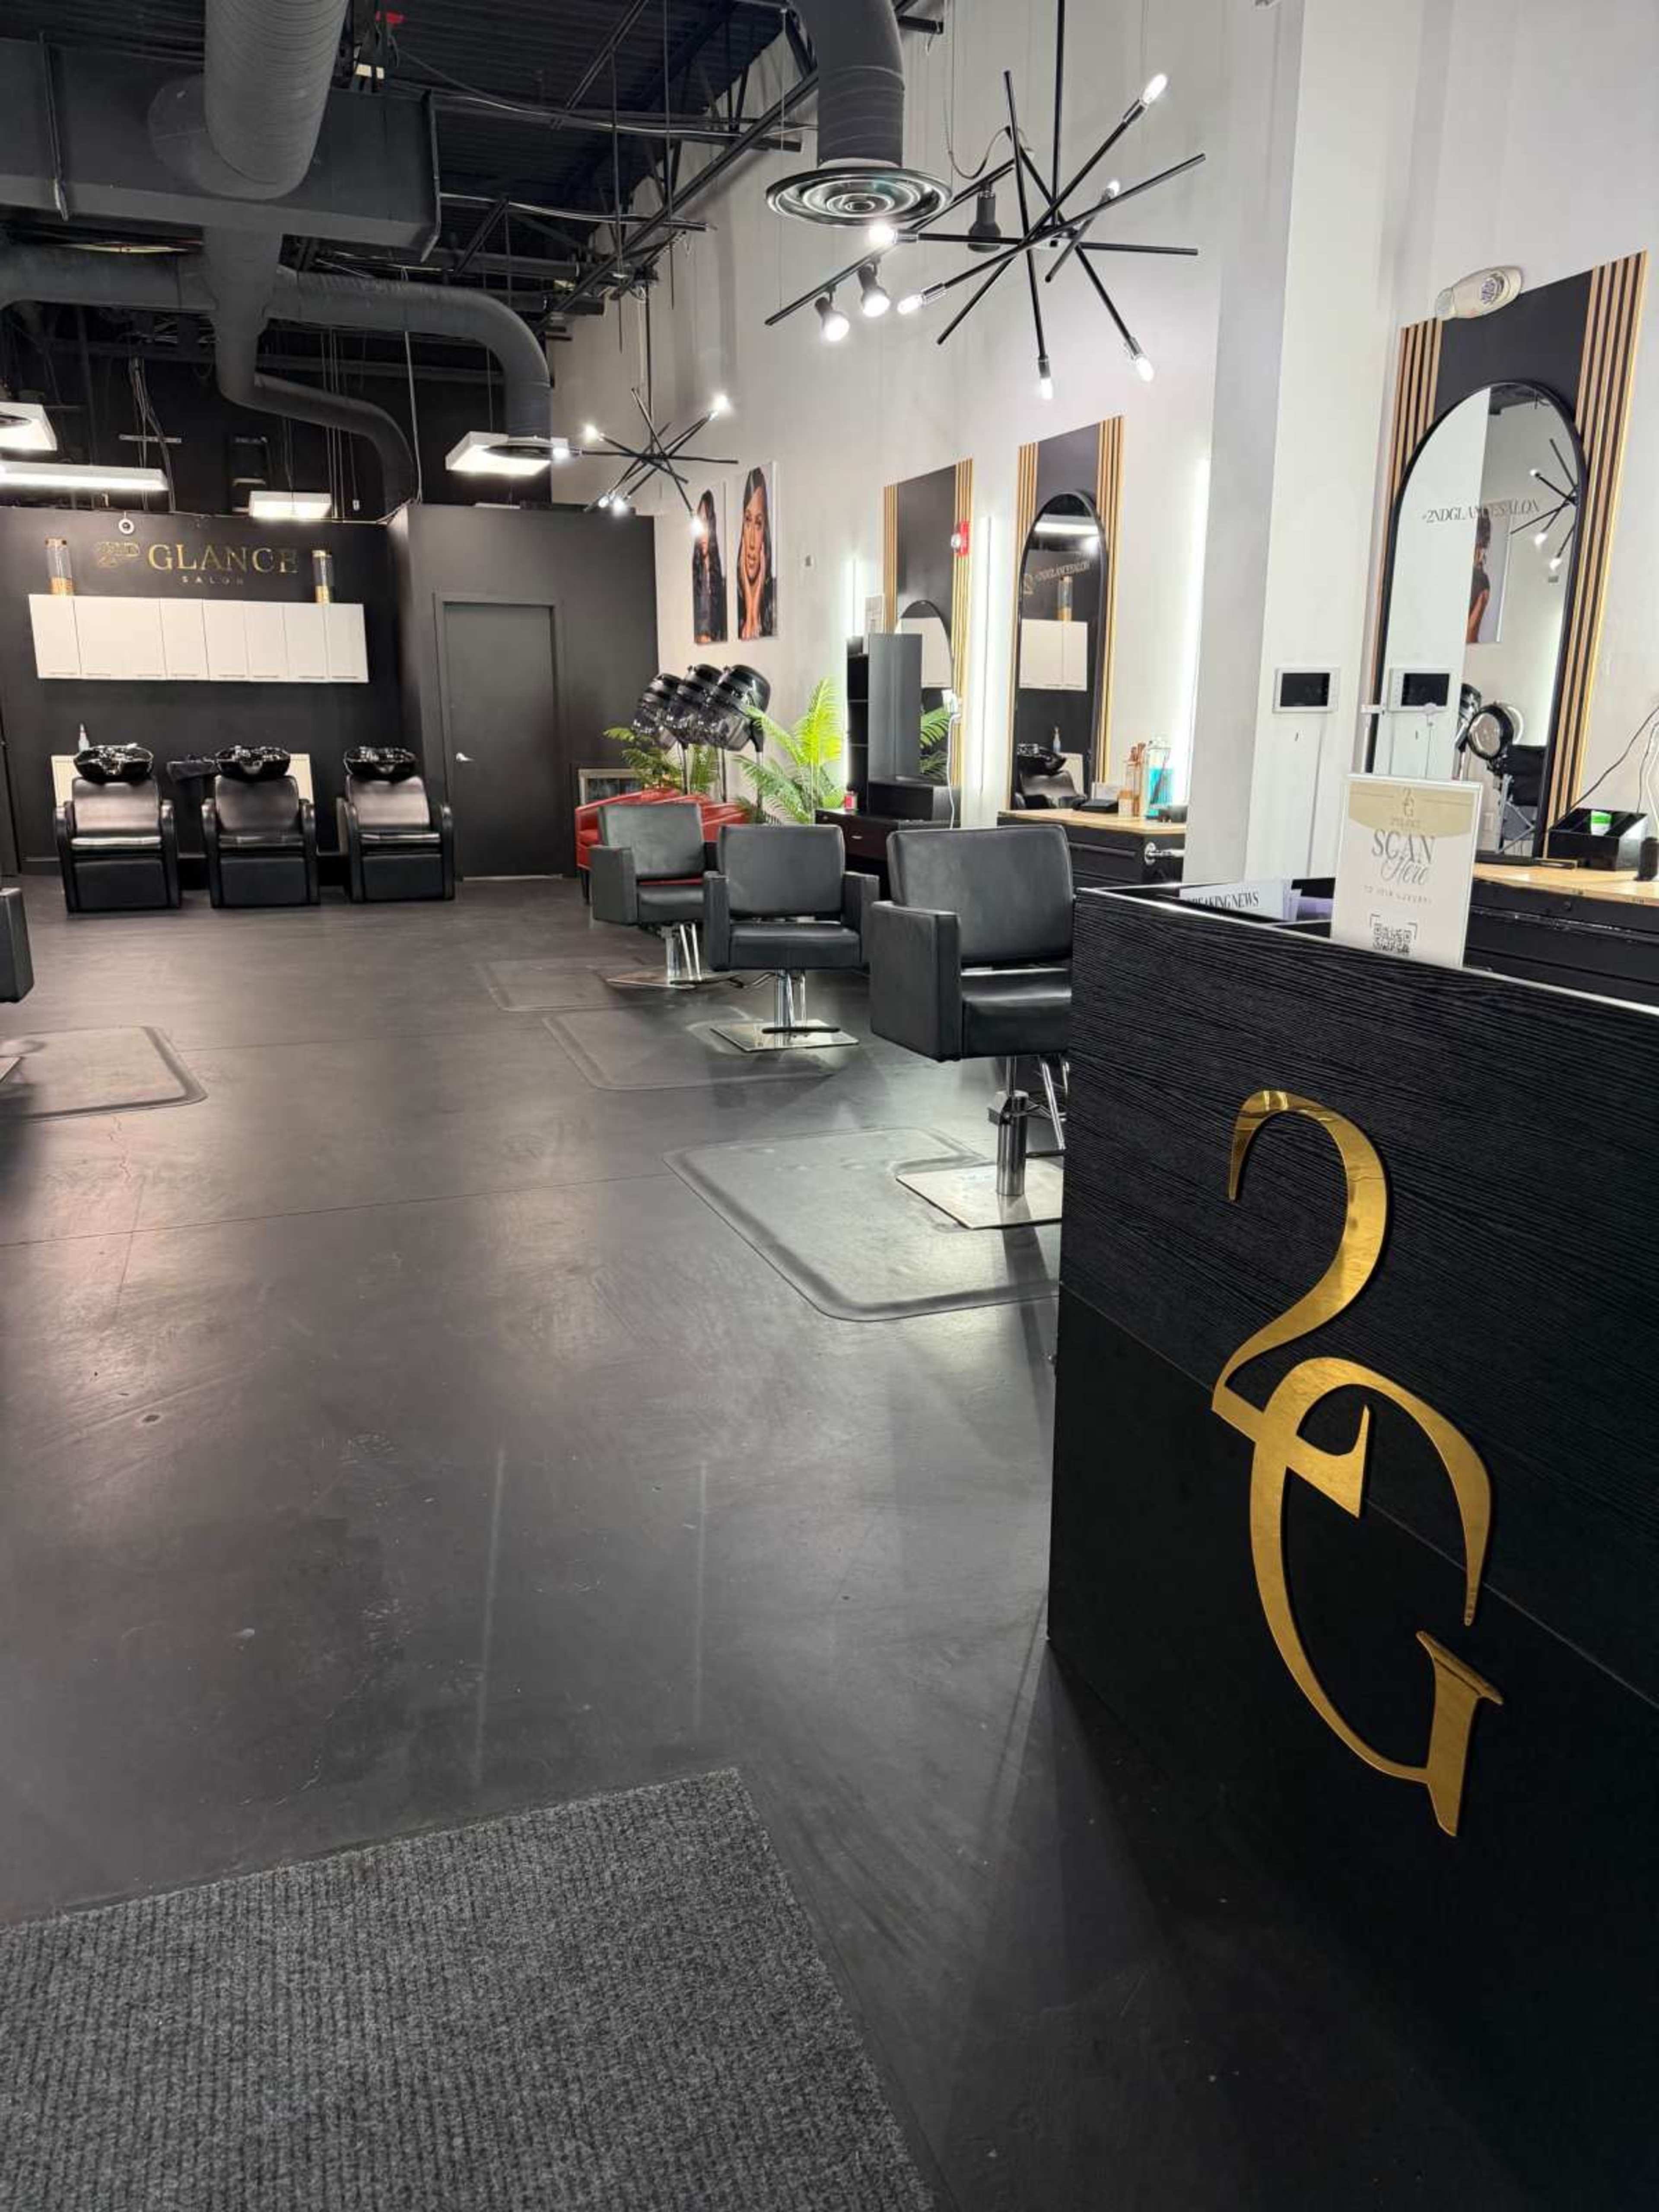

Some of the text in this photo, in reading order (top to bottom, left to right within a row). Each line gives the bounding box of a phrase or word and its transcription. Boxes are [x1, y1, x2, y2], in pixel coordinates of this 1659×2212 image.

[148, 543, 298, 573] GLANCE
[182, 576, 244, 585] SALON
[1371, 829, 1435, 864] SCAN
